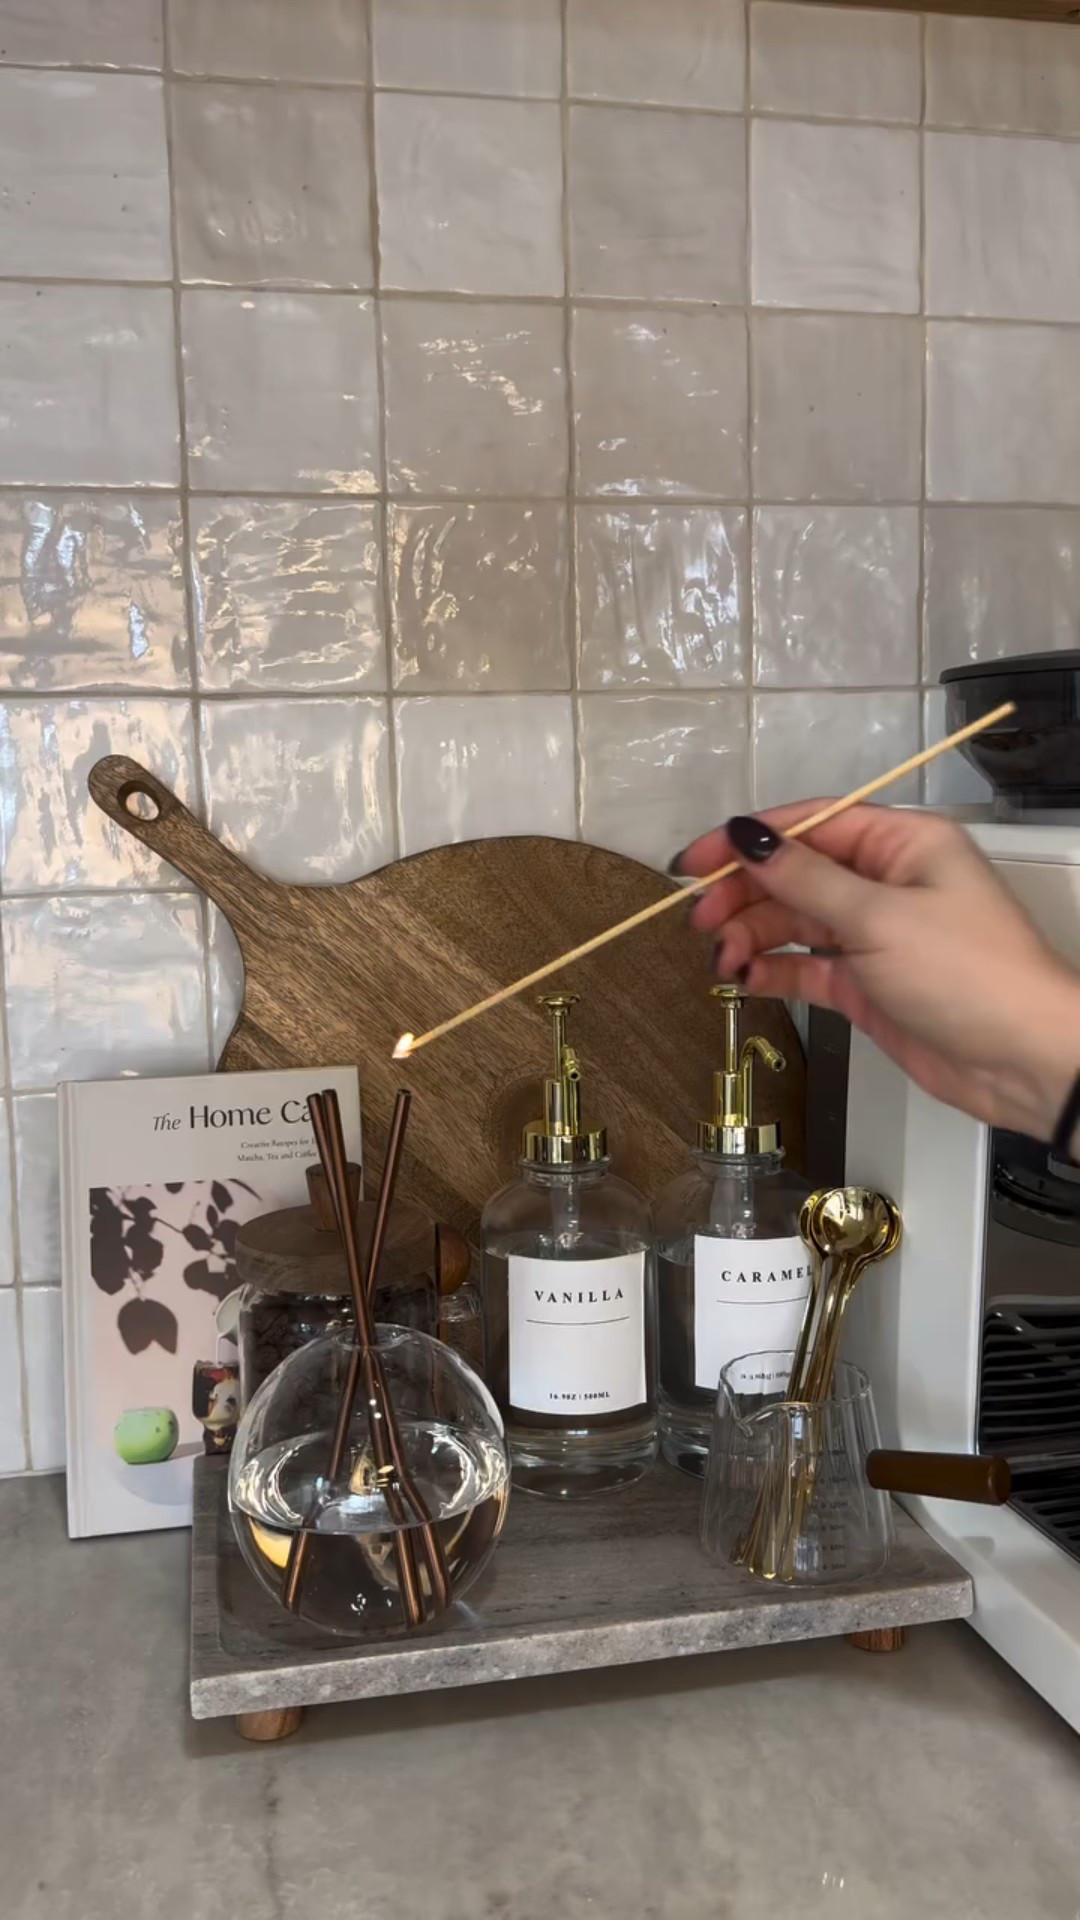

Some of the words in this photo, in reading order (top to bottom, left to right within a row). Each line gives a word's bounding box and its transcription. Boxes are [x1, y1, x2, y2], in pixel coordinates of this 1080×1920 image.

[153, 1113, 181, 1131] The
[190, 1105, 272, 1129] Home
[281, 1100, 313, 1124] Ca
[721, 1264, 813, 1282] CARAMEL
[534, 1287, 624, 1304] VANILLA
